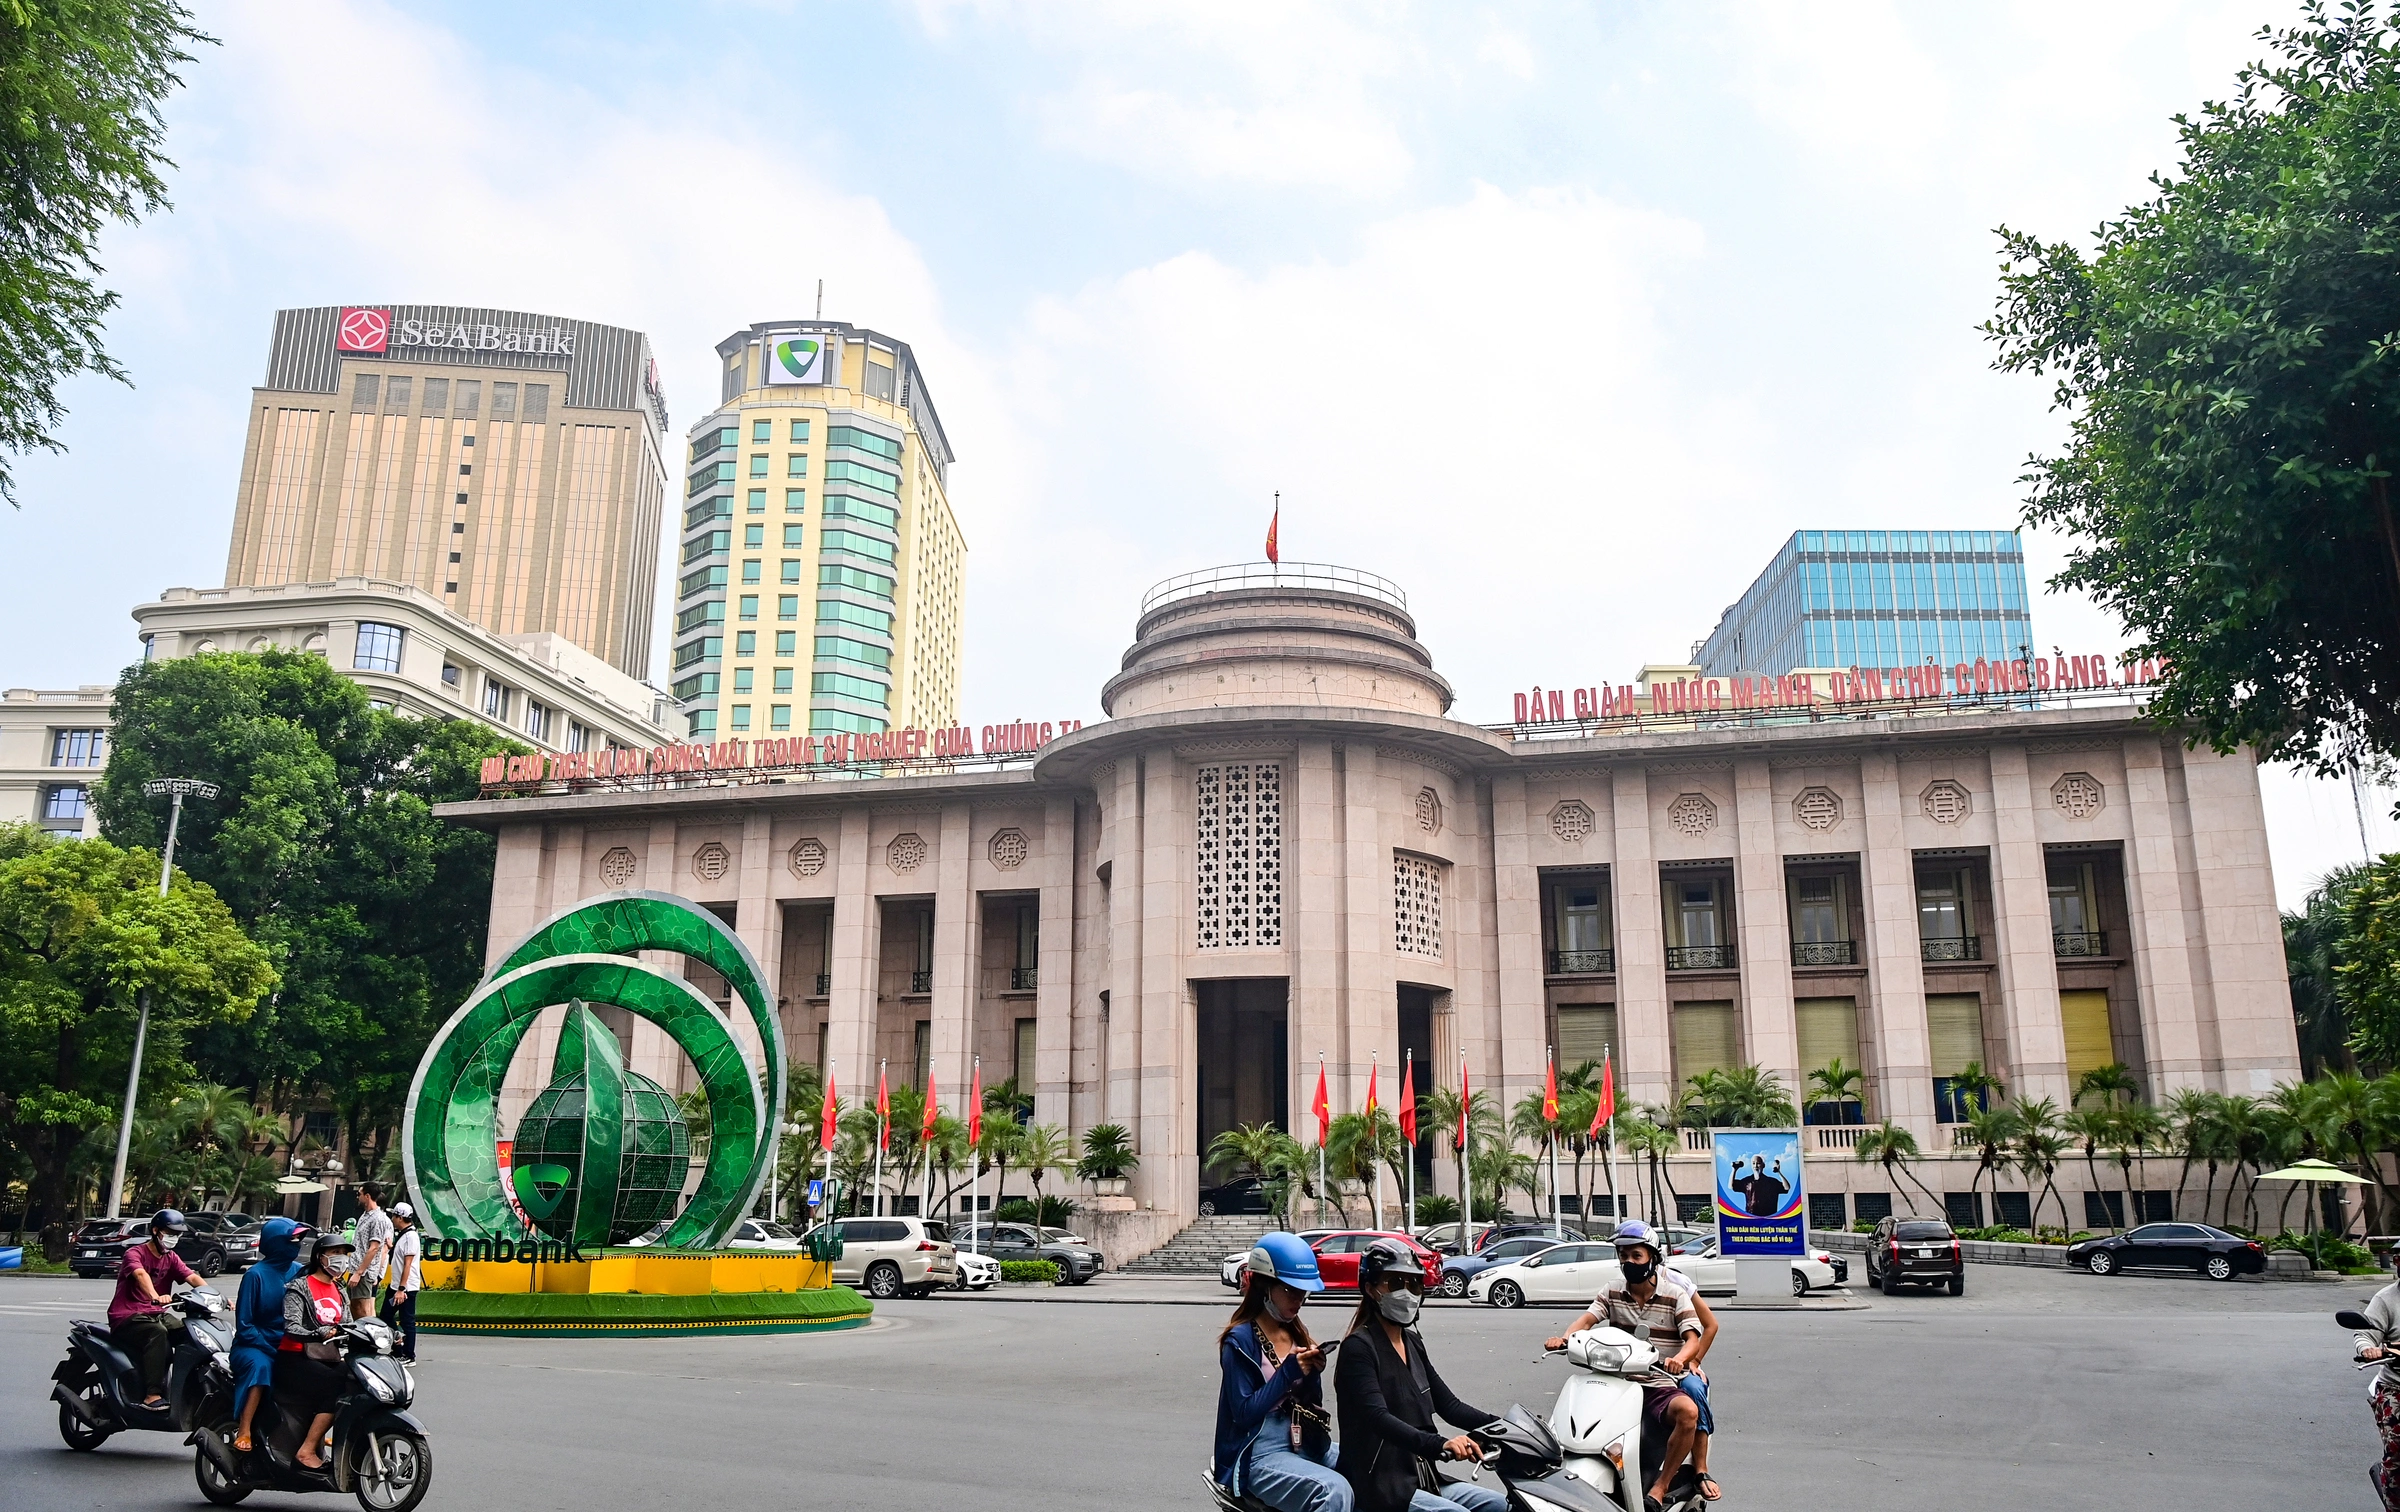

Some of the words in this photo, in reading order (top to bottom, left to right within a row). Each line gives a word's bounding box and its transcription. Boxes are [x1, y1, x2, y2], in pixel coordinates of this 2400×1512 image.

[401, 319, 576, 356] SeABank
[1514, 686, 1564, 723] DÂN
[1573, 681, 1642, 720] GIÀU,
[1652, 673, 1722, 715] NƯỚC
[1831, 665, 1882, 704] DÂN
[1955, 656, 2029, 695] CÔNG
[480, 750, 506, 784] HỒ
[507, 747, 545, 783] CHỦ
[549, 751, 589, 785] TỊCH
[652, 737, 705, 774] SỐNG
[708, 737, 748, 770] MÃI
[753, 735, 816, 767] TRONG
[822, 731, 850, 767] SỰ
[853, 726, 927, 766] NGHIỆP
[934, 719, 973, 757] CỦA
[982, 718, 1052, 754] CHÚNG
[421, 1230, 588, 1264] combank
